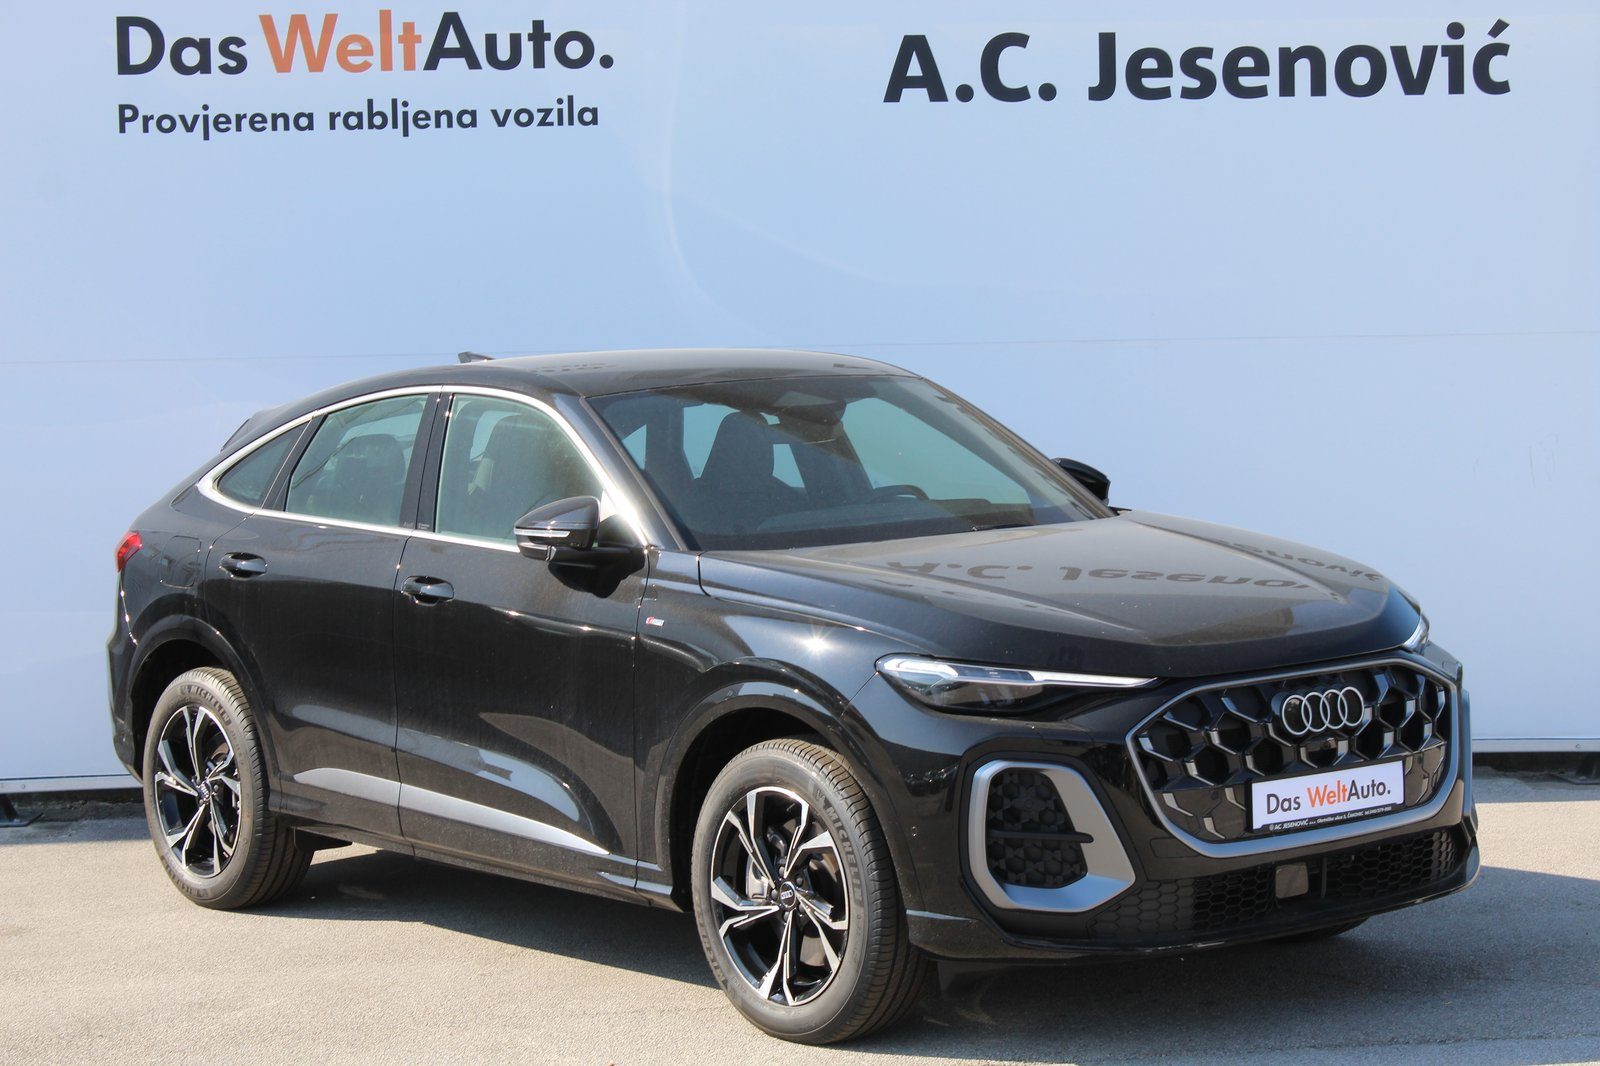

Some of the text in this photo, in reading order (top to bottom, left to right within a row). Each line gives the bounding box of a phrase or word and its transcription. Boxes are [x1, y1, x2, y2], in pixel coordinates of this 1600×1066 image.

[115, 9, 614, 76] Das WeltAuto.
[882, 18, 1511, 103] A.C. Jesenović
[118, 94, 599, 141] Provjerena rabljena vozila
[191, 685, 232, 725] MICHELIN
[1266, 779, 1391, 815] Das WeltAuto.
